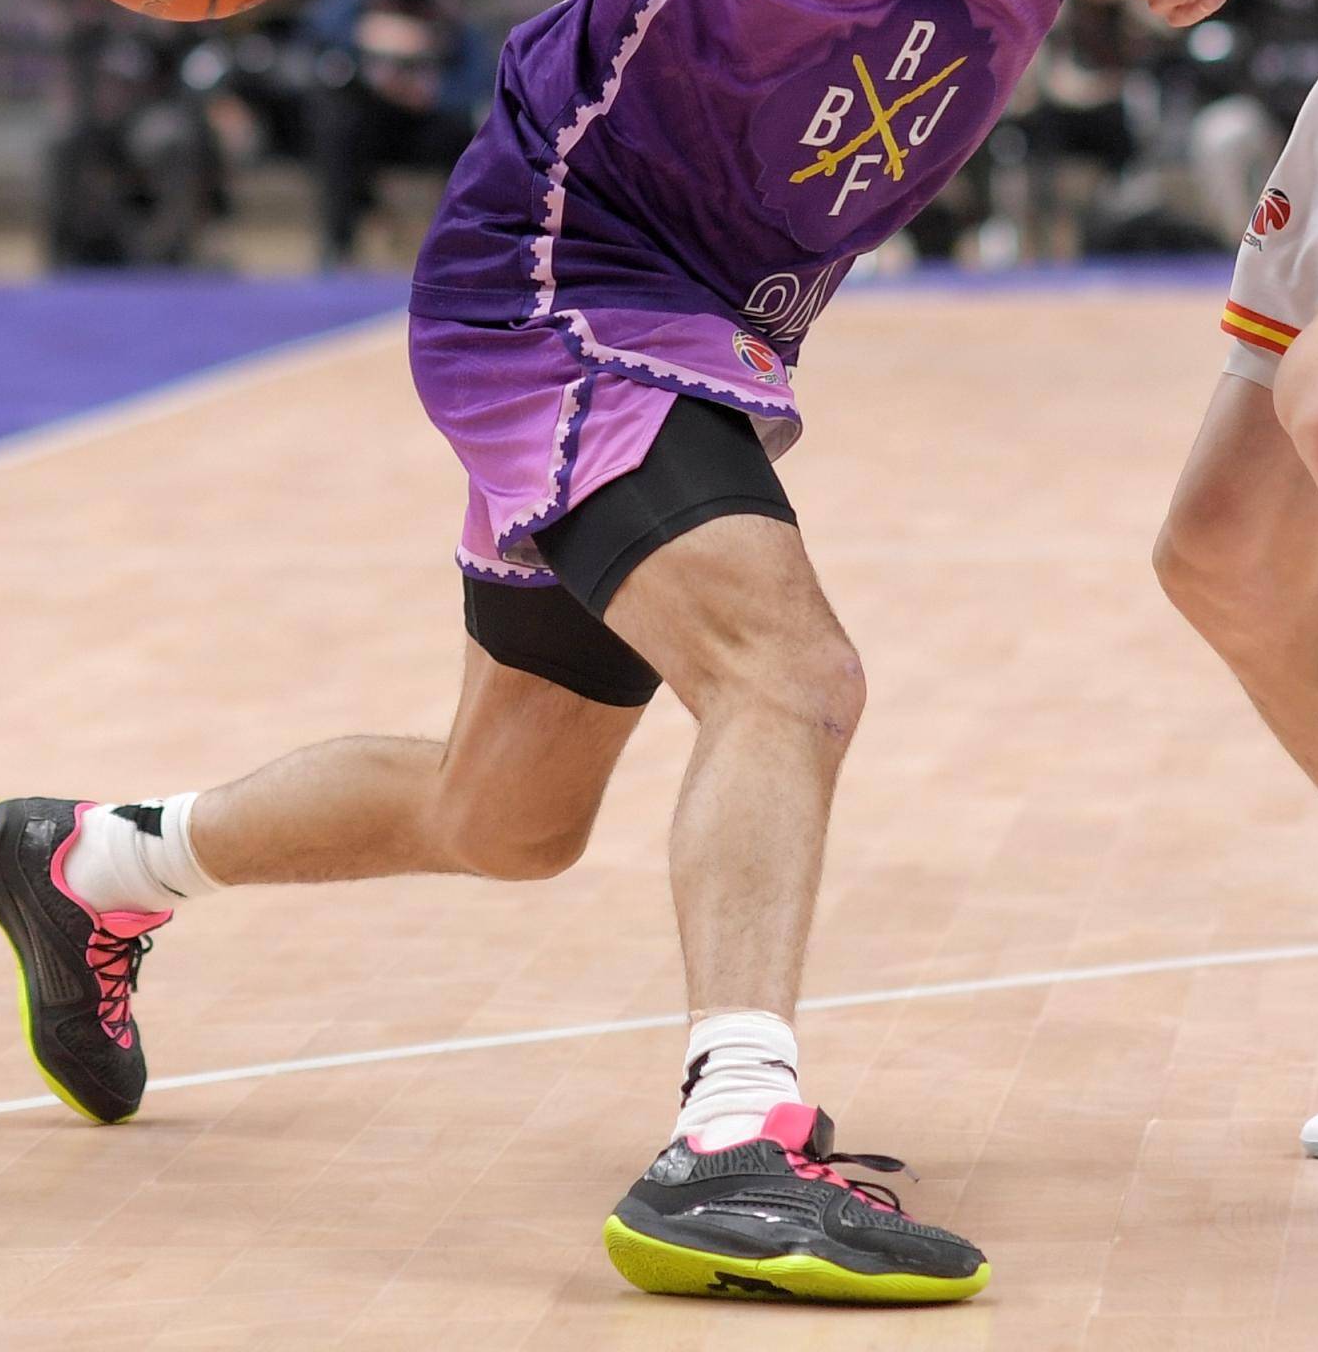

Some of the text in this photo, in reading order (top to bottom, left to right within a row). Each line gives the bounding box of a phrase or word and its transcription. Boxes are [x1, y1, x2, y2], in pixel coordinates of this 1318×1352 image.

[884, 19, 937, 81] R
[798, 85, 960, 147] B J
[827, 153, 883, 216] F
[1243, 232, 1263, 253] CBA
